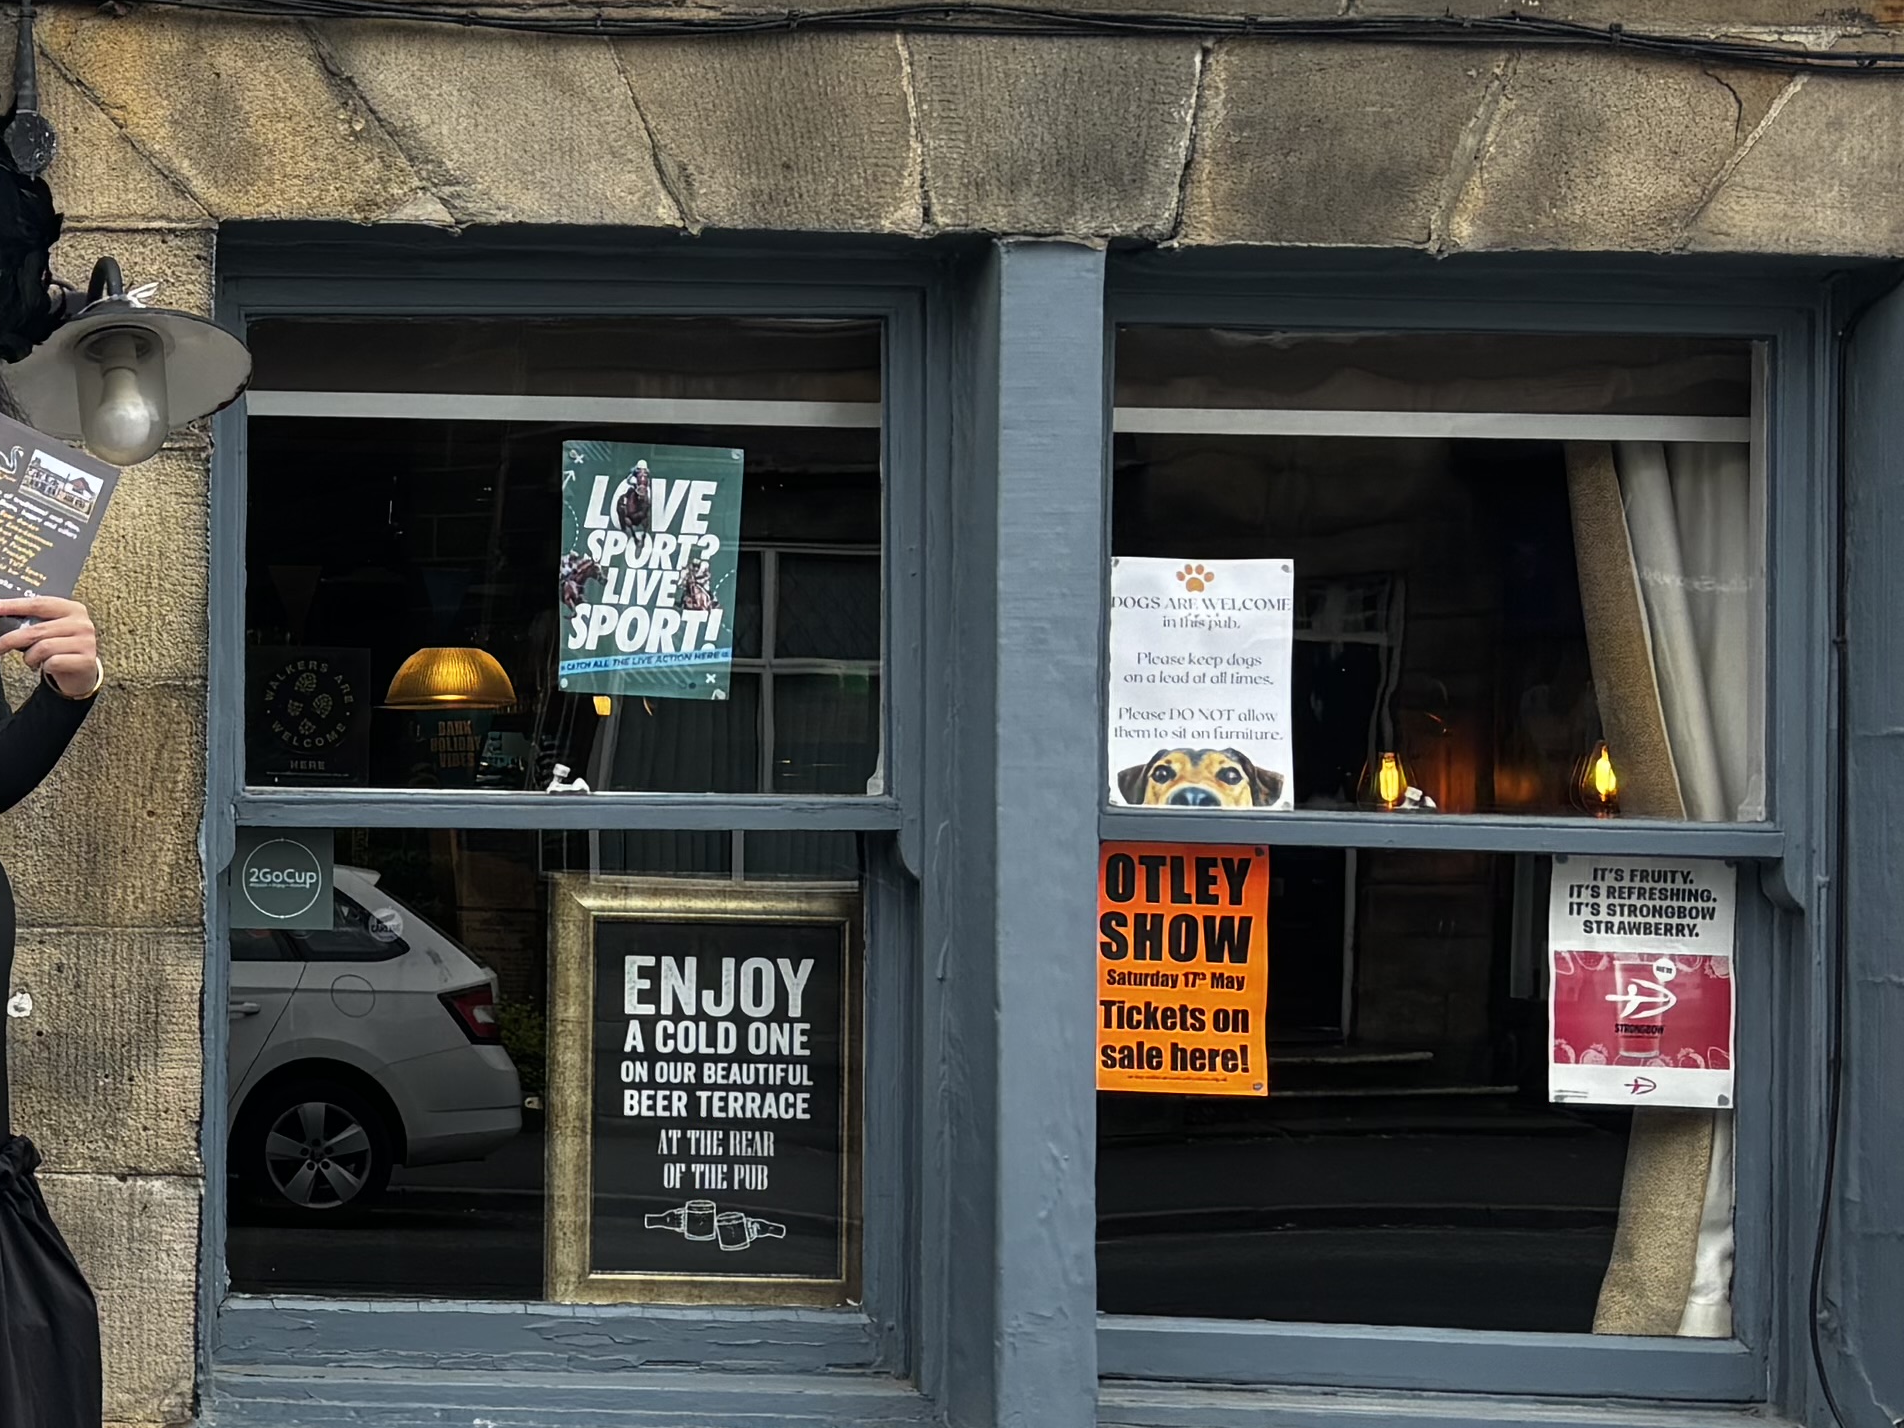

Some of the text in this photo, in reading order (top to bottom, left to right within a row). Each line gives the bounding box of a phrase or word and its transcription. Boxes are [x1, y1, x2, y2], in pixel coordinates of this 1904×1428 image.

[587, 529, 720, 571] SPORT?
[601, 567, 680, 607] LIVE
[1111, 596, 1291, 612] DOGS ARE WELCOME
[568, 603, 724, 654] SPORT!
[1162, 615, 1241, 631] in this pub.
[566, 650, 720, 671] CATCH ALL THE LIVE ACTION HERE
[1137, 652, 1262, 669] Please keep dogs
[264, 660, 354, 704] WALKERS ARE
[1123, 671, 1274, 685] on a lead at all times.
[1118, 707, 1278, 722] Please DO NOT allow
[271, 720, 346, 748] WELCOME
[430, 735, 482, 752] HOLIDAY
[1114, 726, 1284, 741] them to sit on furniture.
[290, 760, 326, 770] HERE
[249, 868, 318, 888] 2GoCup
[1105, 852, 1252, 906] OTLEY
[1592, 867, 1694, 884] IT'S FRUITY.
[1568, 884, 1718, 903] IT'S REFRESHING.
[1568, 902, 1716, 921] IT'S STRONGBOW
[1099, 911, 1253, 964] SHOW
[1583, 920, 1700, 938] STRAWBERRY.
[624, 954, 815, 1018] ENJOY
[1106, 969, 1179, 989] Saturday
[1210, 972, 1245, 991] May
[1099, 1000, 1250, 1034] Tickets on
[623, 1019, 811, 1056] A COLD ONE
[1614, 1023, 1665, 1035] STRONGBOW
[1101, 1041, 1250, 1073] sale here!
[620, 1060, 814, 1086] ON OUR BEAUTIFUL
[623, 1089, 811, 1120] BEER TERRACE
[657, 1129, 775, 1157] AT THE REAR
[663, 1163, 769, 1190] OF THE PUB
